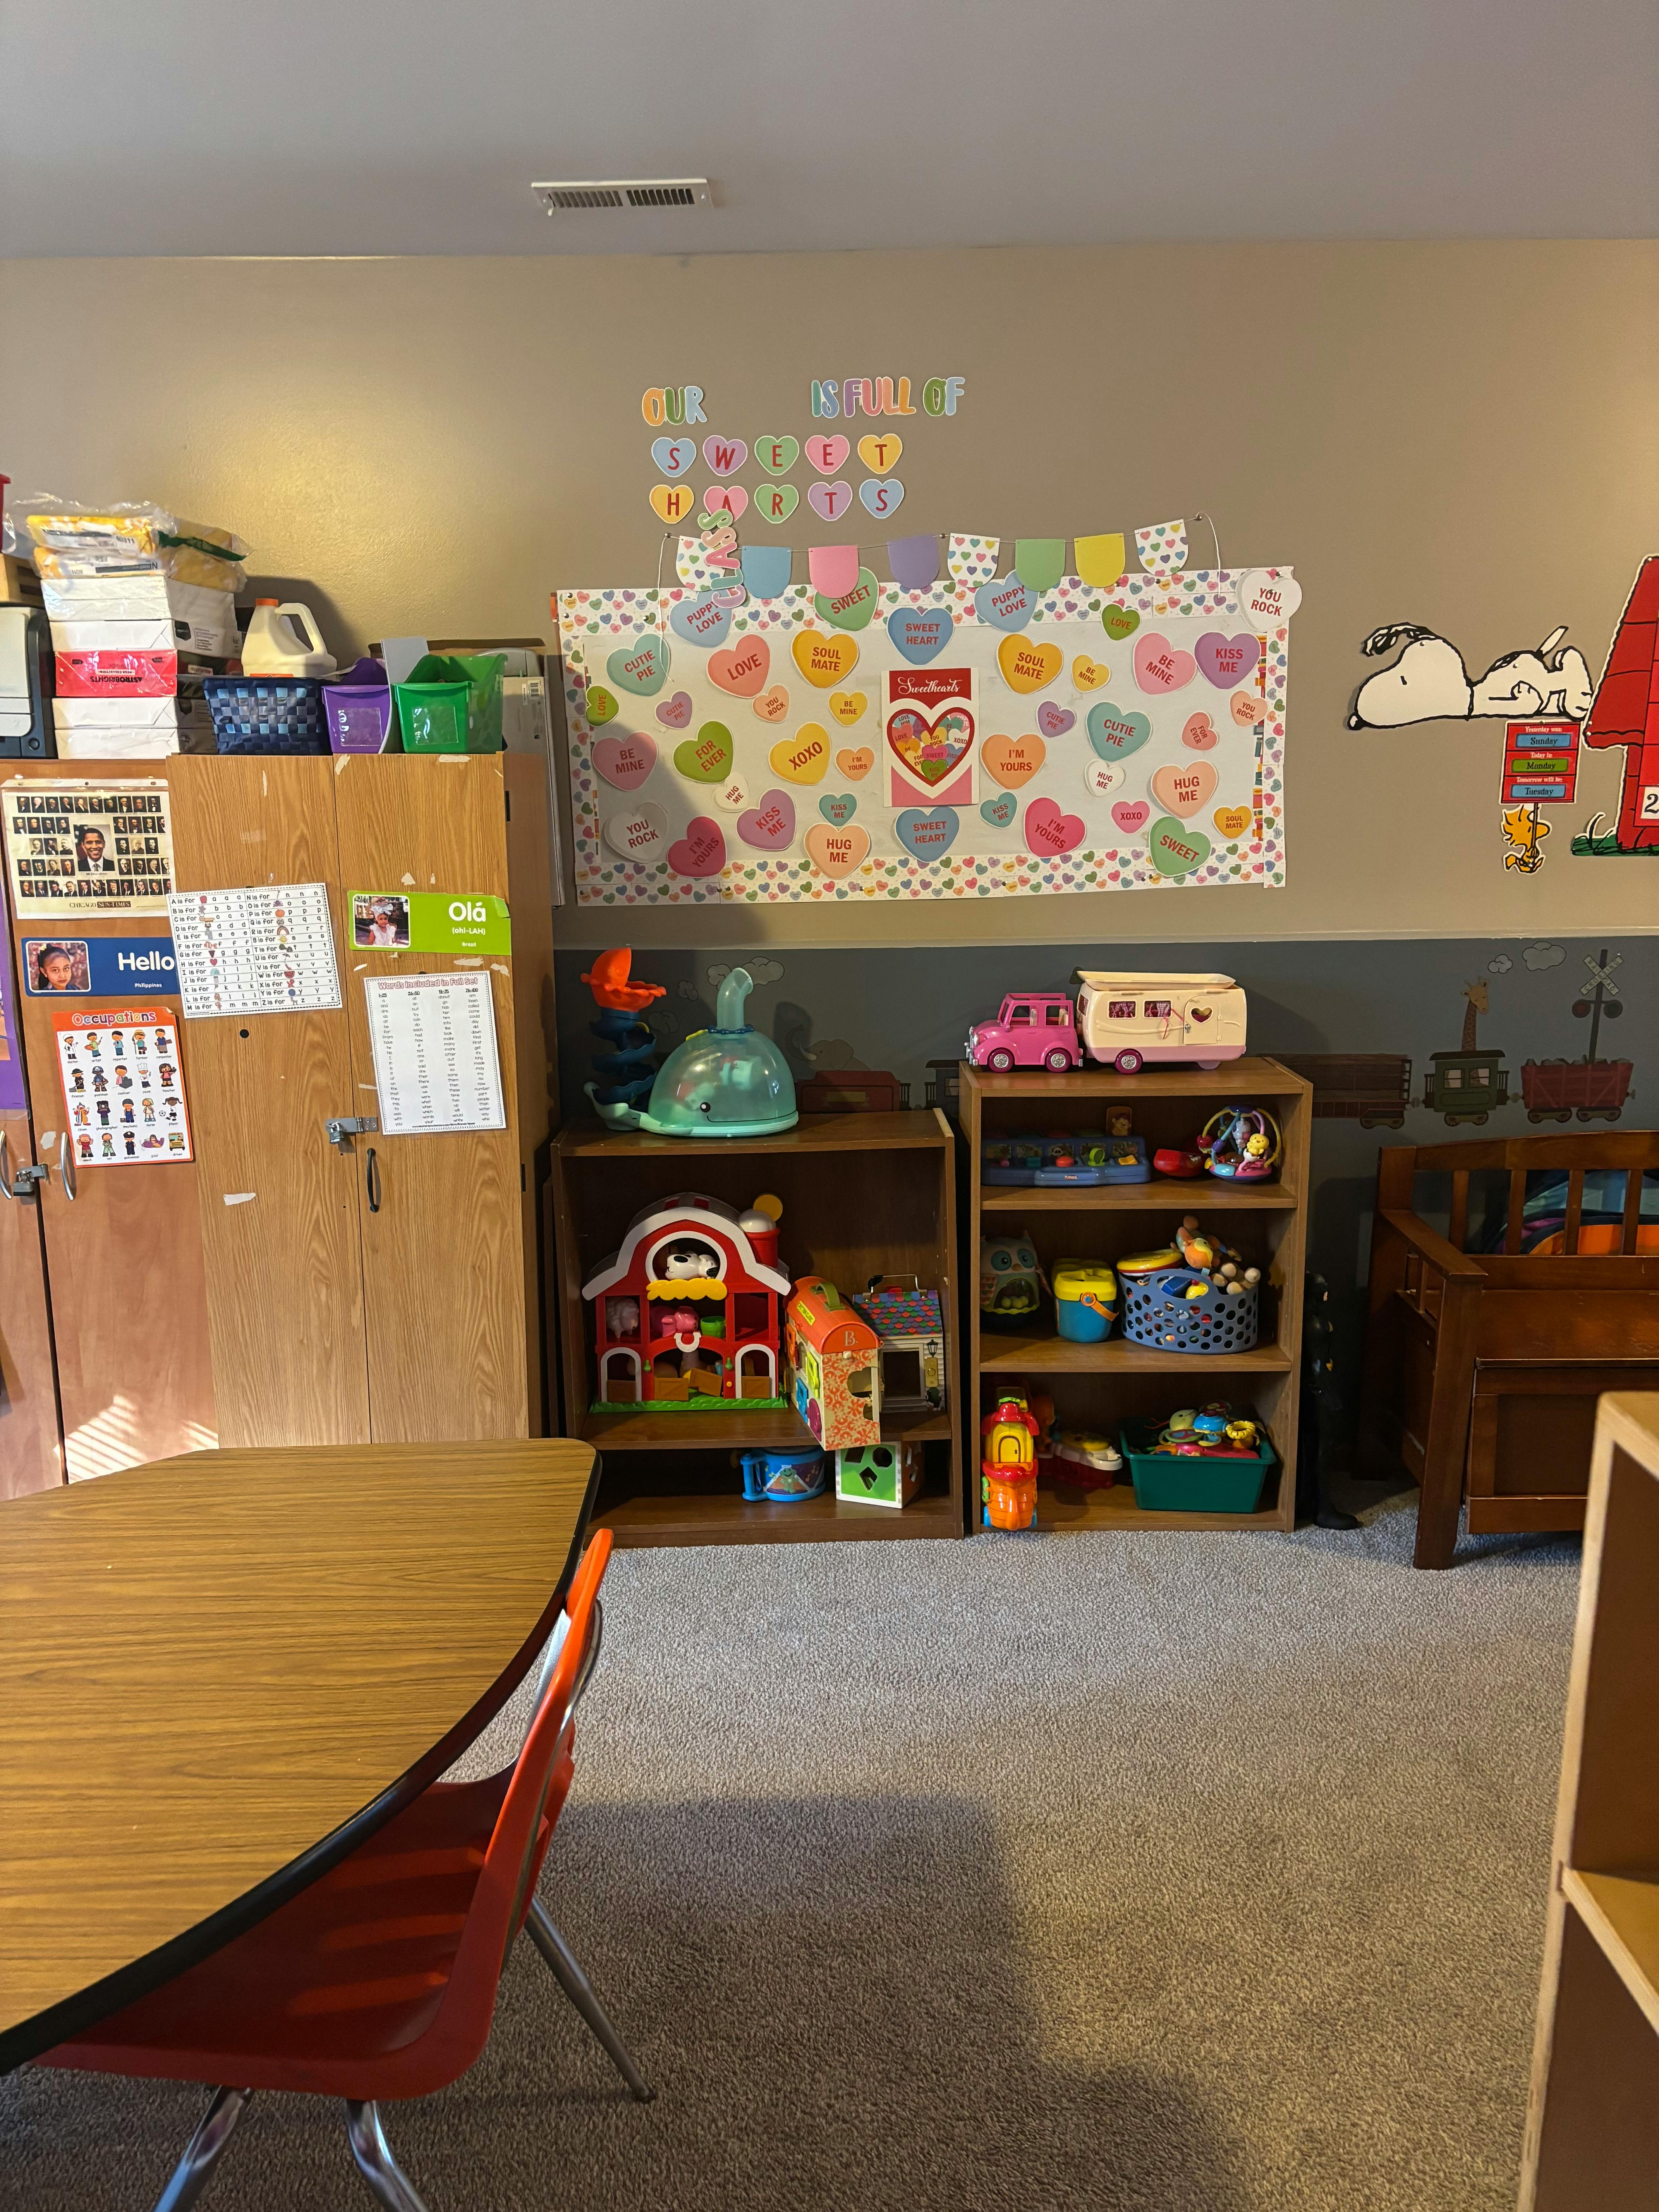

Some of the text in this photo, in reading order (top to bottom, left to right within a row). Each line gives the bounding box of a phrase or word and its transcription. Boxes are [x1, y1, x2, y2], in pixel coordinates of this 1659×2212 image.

[812, 376, 965, 418] IS FULL OF
[642, 386, 707, 426] OUR
[698, 509, 746, 608] CLASS
[831, 585, 871, 615] SWEET
[991, 586, 1025, 606] PUPPY
[1260, 588, 1282, 603] YOU
[1000, 599, 1027, 617] LOVE
[1251, 599, 1283, 616] ROCK
[696, 611, 723, 633] LOVE
[906, 623, 940, 632] SWEET
[1111, 617, 1132, 629] LOVE
[907, 637, 939, 645] HEART
[813, 647, 841, 659] SOUL
[1017, 652, 1045, 668] SOUL
[1216, 649, 1243, 659] KISS
[625, 650, 655, 673] CUTIE
[727, 654, 762, 680] LOVE
[811, 659, 840, 671] MATE
[1158, 654, 1175, 670] BE
[1219, 662, 1238, 672] ME
[637, 668, 655, 681] PIE
[1013, 663, 1043, 680] MATE
[1078, 671, 1096, 685] MINE
[1086, 666, 1096, 676] BE
[1146, 662, 1175, 685] MINE
[898, 677, 962, 694] Sweethearts
[597, 694, 606, 716] LOVE
[666, 701, 684, 716] CUTIE
[765, 697, 779, 708] YOU
[768, 702, 786, 716] ROCK
[1242, 702, 1256, 712] YOU
[674, 711, 685, 720] PIE
[1046, 712, 1065, 725] CUTIE
[1236, 708, 1255, 721] ROCK
[1047, 720, 1058, 730] PIE
[1104, 719, 1136, 737] CUTIE
[1190, 728, 1201, 744] EVER
[1198, 725, 1209, 740] FOR
[1106, 734, 1125, 747] PIE
[1531, 737, 1558, 746] Sunday
[620, 749, 634, 760] BE
[695, 740, 716, 760] FOR
[788, 742, 823, 771] XOXO
[1009, 749, 1024, 758] I'M
[615, 760, 644, 773] MINE
[701, 749, 726, 772] EVER
[1000, 763, 1032, 771] YOURS
[1527, 762, 1556, 771] Monday
[1097, 771, 1113, 783] HUG
[1174, 776, 1200, 790] HUG
[1096, 780, 1108, 789] ME
[725, 785, 740, 800] HUG
[732, 792, 744, 804] ME
[1179, 790, 1197, 802] ME
[1525, 788, 1554, 796] Tuesday
[992, 803, 1009, 815] KISS
[1120, 812, 1142, 820] XOXO
[756, 806, 781, 830] KISS
[998, 812, 1009, 821] ME
[626, 819, 649, 835] YOU
[768, 821, 786, 836] ME
[914, 821, 947, 831] SWEET
[1047, 819, 1065, 834] I'M
[628, 830, 659, 848] ROCK
[915, 834, 946, 844] HEART
[1035, 824, 1066, 848] YOURS
[689, 836, 706, 854] I'M
[826, 838, 852, 850] HUG
[1160, 835, 1200, 863] SWEET
[692, 837, 720, 868] YOURS
[829, 852, 848, 863] ME
[449, 902, 486, 922] Olá
[118, 951, 175, 970] Hello
[405, 980, 440, 988] Included
[72, 1012, 156, 1025] Occupations
